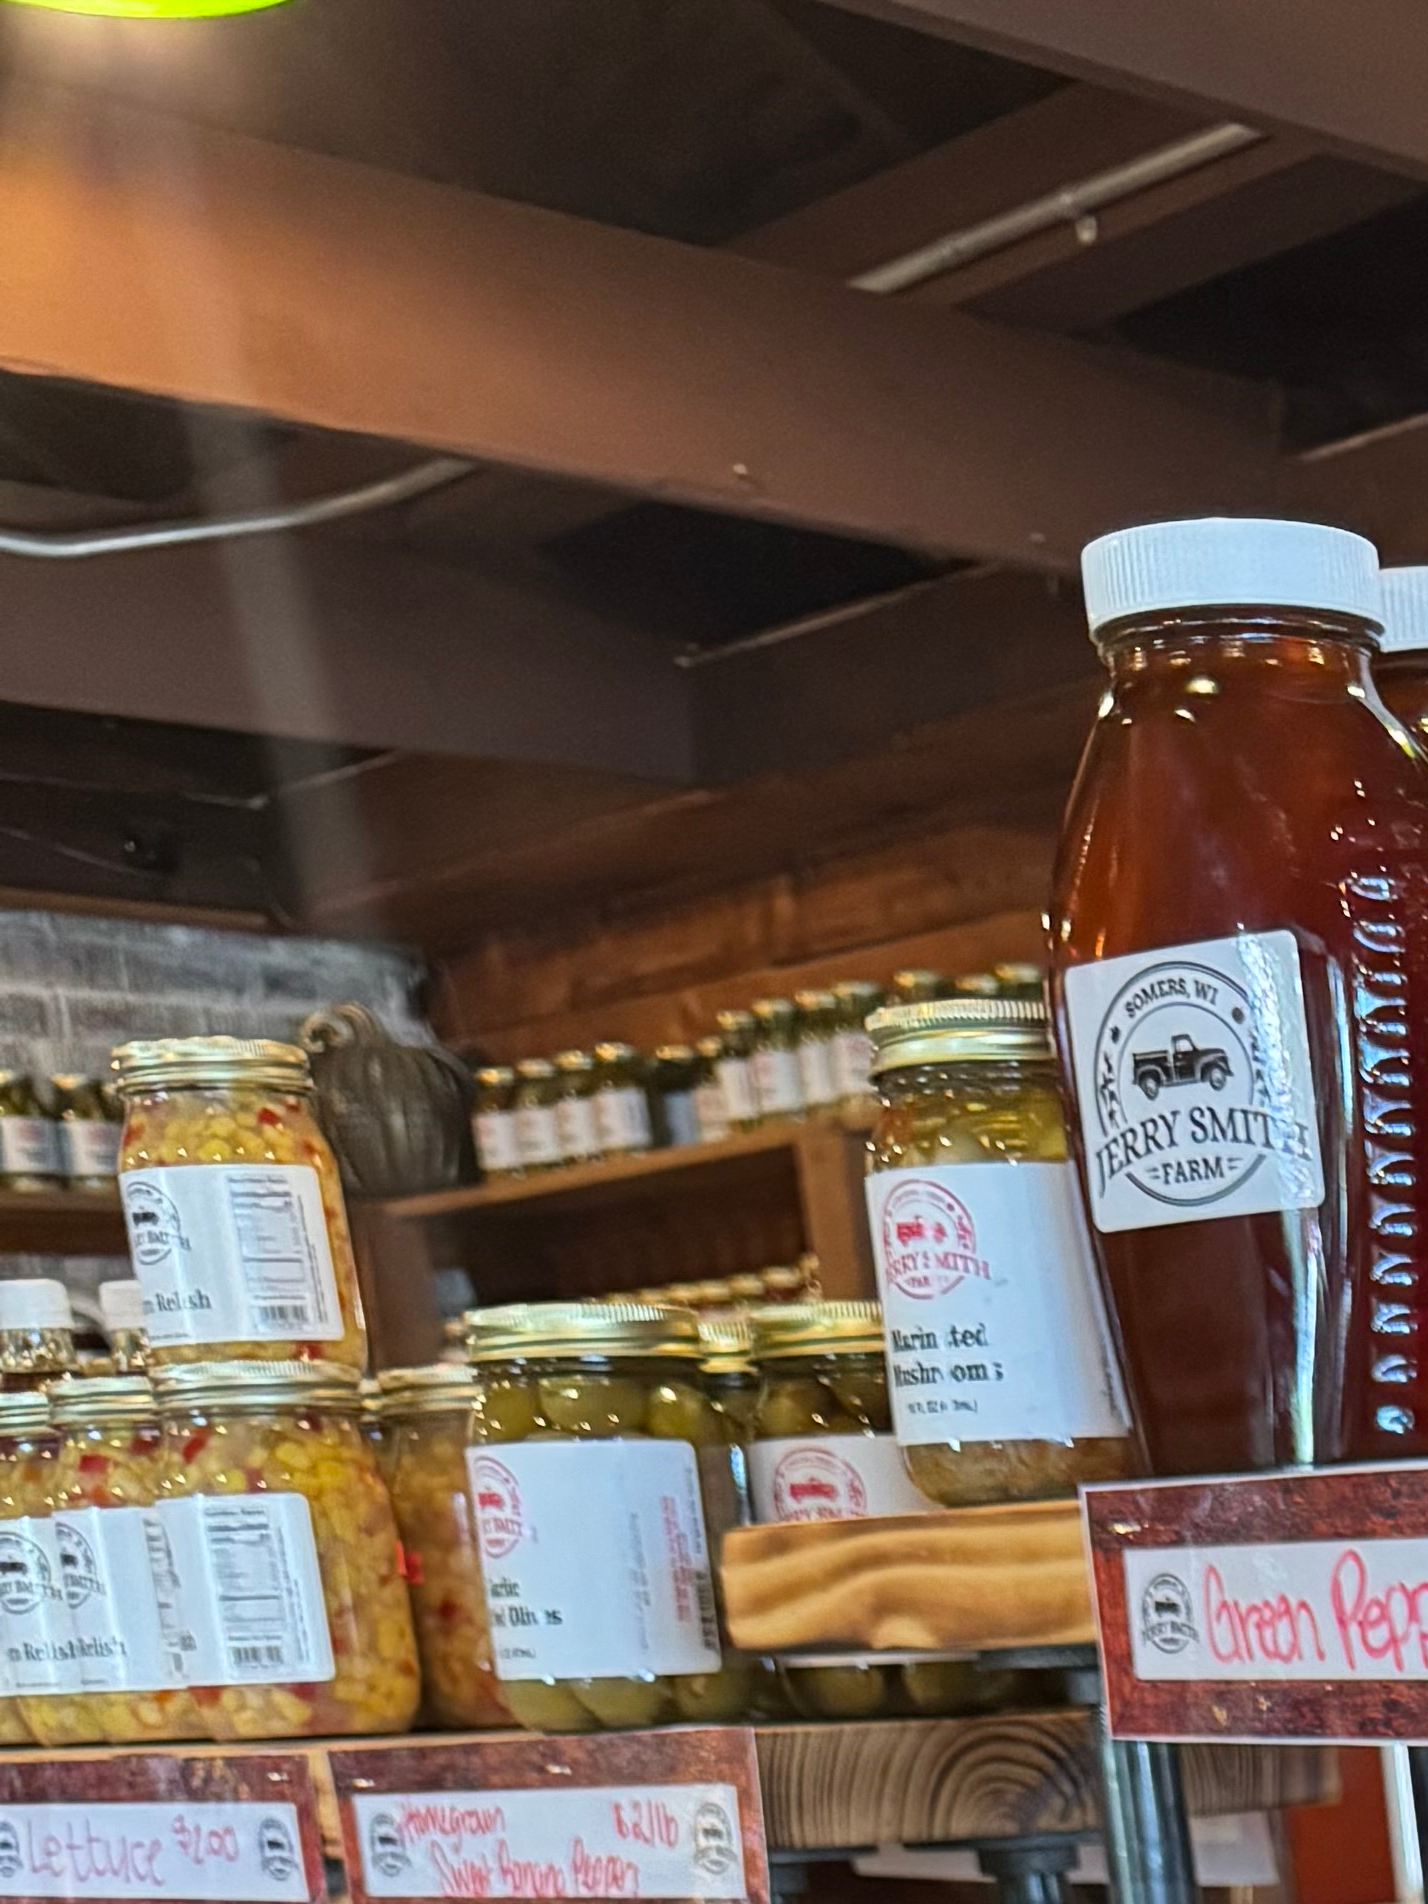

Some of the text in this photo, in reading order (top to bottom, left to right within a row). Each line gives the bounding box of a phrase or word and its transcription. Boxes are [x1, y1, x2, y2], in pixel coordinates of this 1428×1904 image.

[1123, 977, 1219, 1018] SOMERS, WI
[1095, 1106, 1313, 1199] JERRY SMITH
[1162, 1157, 1225, 1186] FARM
[1202, 1564, 1325, 1664] Green
[27, 1817, 165, 1887] Lettuce
